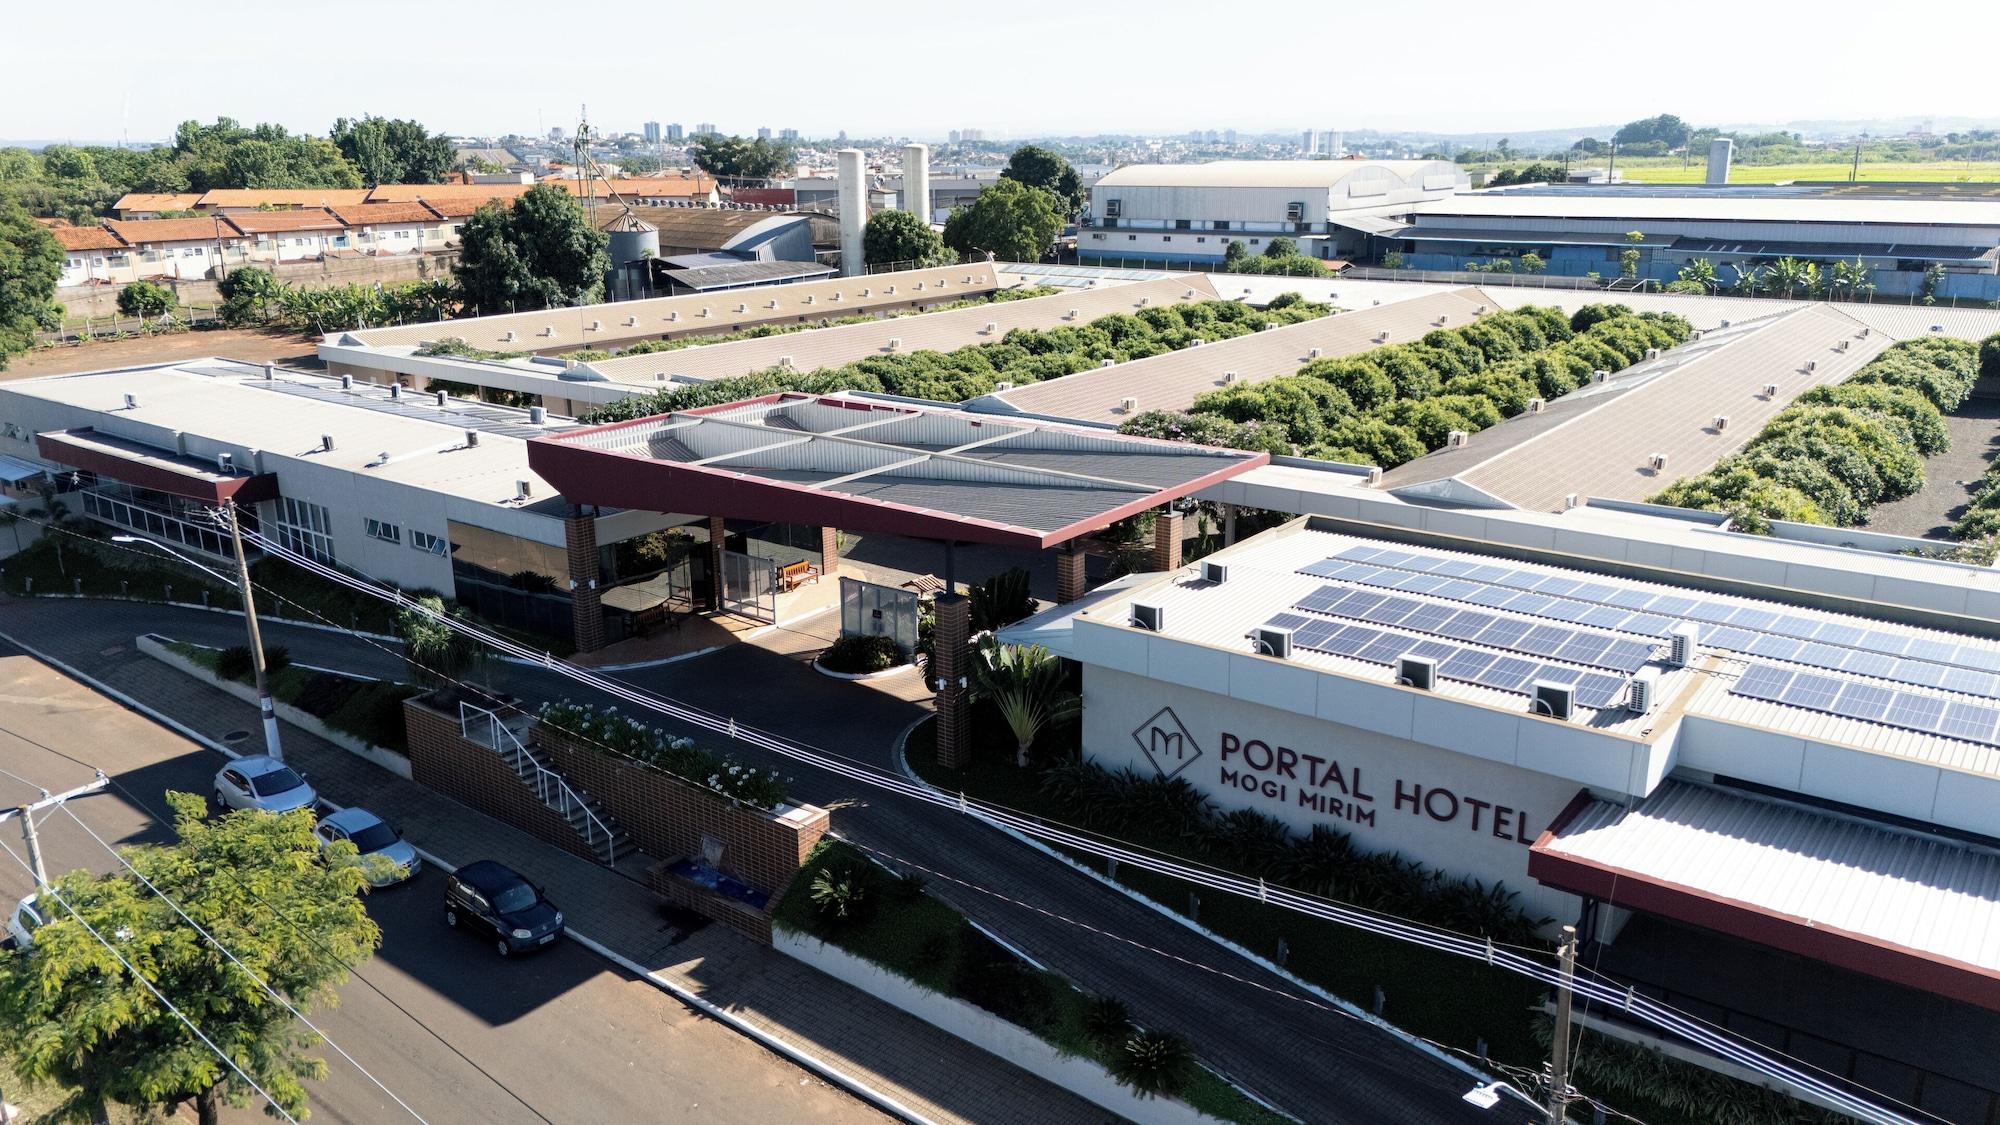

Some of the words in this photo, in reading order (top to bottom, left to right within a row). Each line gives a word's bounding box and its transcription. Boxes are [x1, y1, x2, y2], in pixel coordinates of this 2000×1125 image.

[1220, 766, 1286, 802] MOGI
[1299, 788, 1376, 828] MIRIM
[1221, 732, 1374, 802] PORTAL
[1394, 779, 1536, 846] HOTEL
